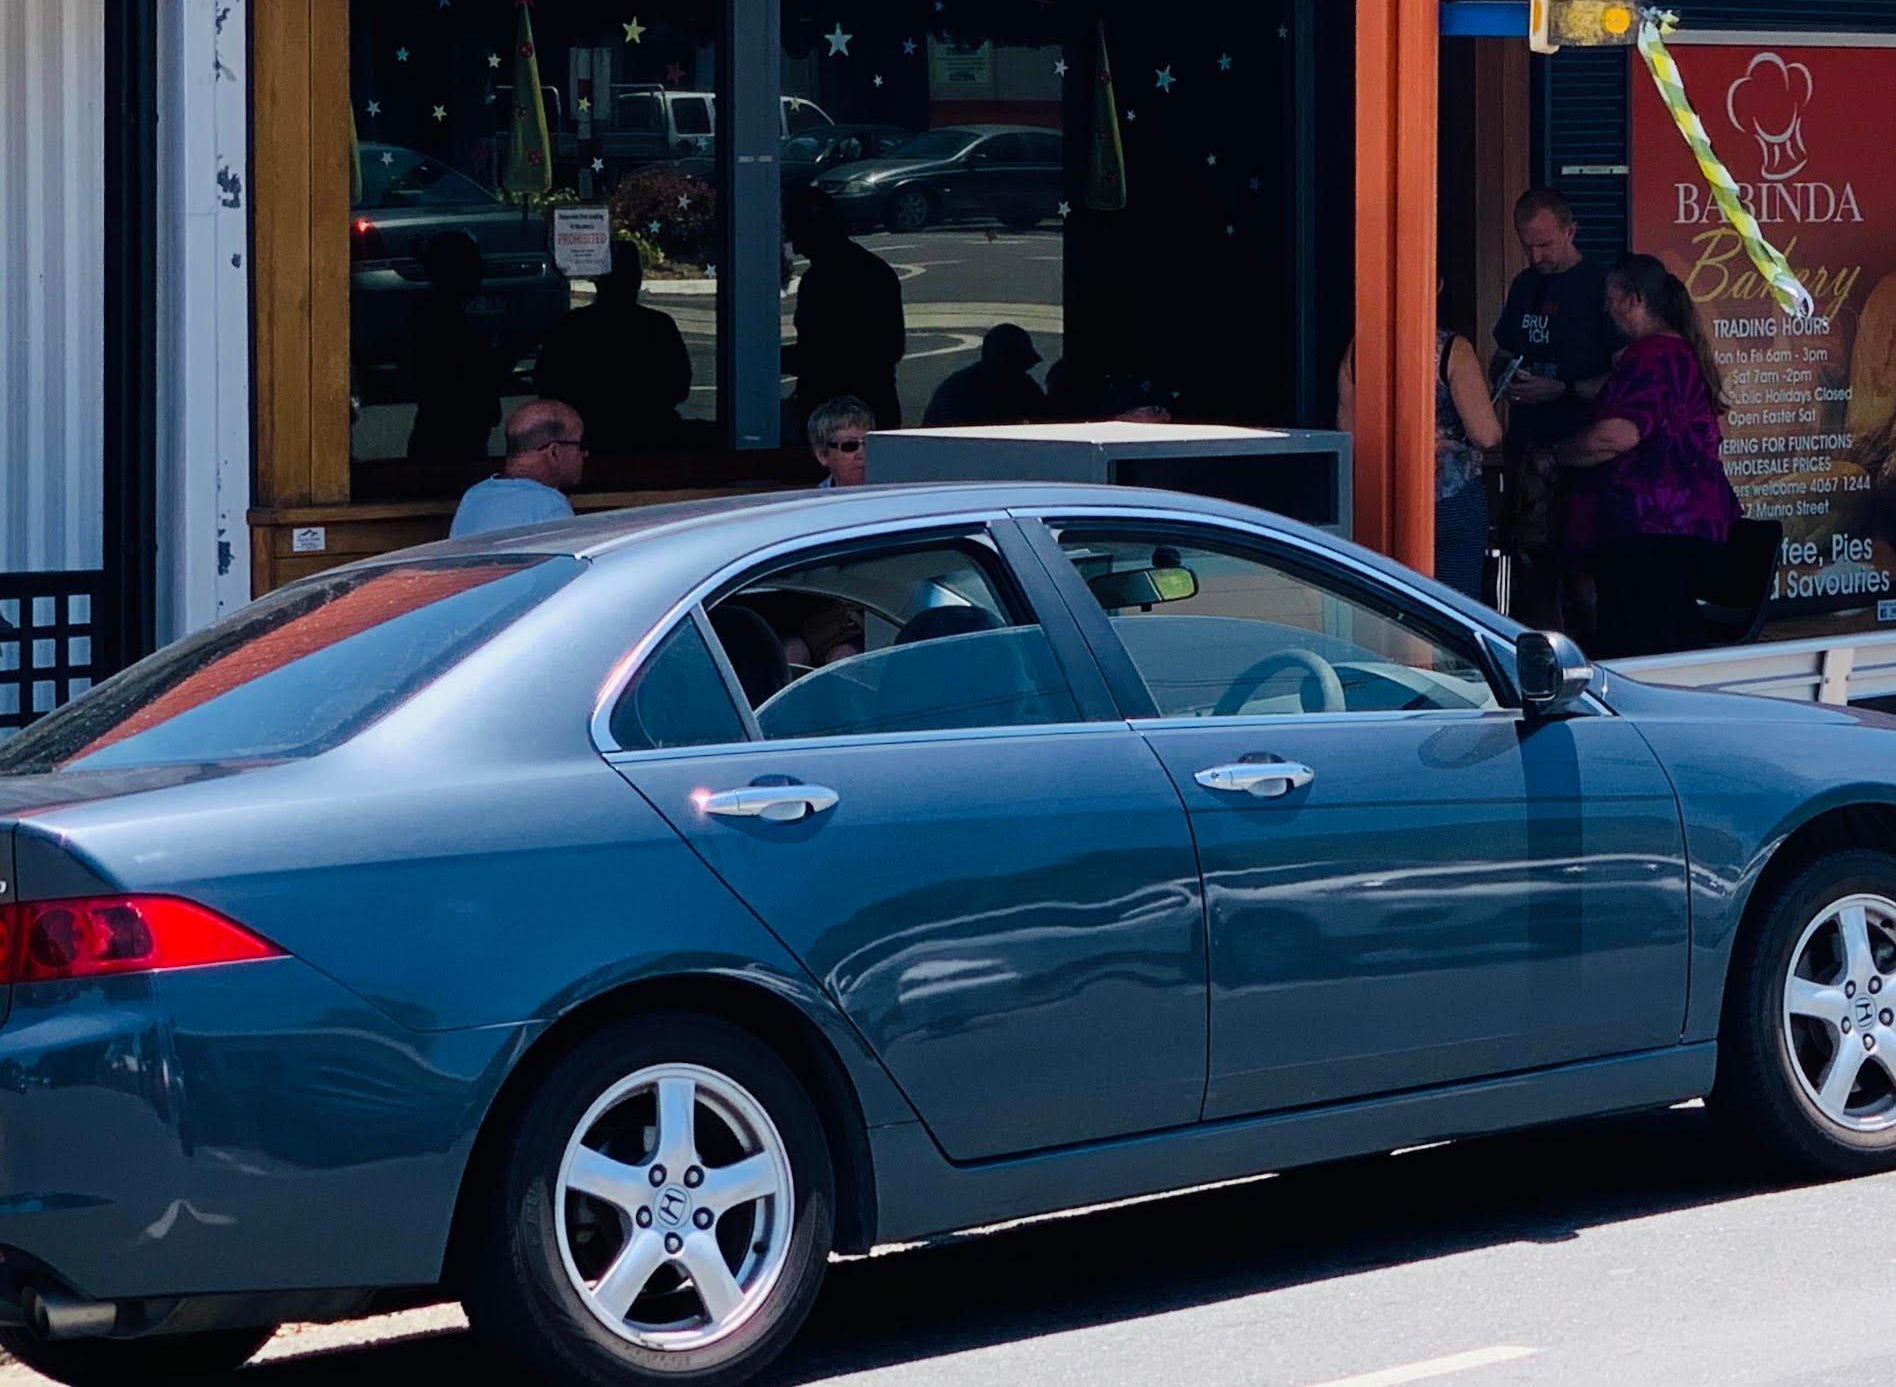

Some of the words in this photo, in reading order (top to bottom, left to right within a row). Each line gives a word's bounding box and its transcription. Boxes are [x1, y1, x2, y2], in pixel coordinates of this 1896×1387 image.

[1712, 318, 1776, 338] TRADING
[1782, 317, 1830, 336] HOURS
[1736, 349, 1748, 363] to
[1750, 349, 1763, 363] Fri
[1766, 348, 1791, 363] 6am
[1802, 346, 1828, 364] 3pm
[1731, 370, 1750, 384] Sat
[1754, 369, 1780, 383] 7am
[1765, 388, 1812, 405] Holidays
[1814, 386, 1853, 402] Closed
[1727, 411, 1760, 427] Open
[1763, 409, 1795, 424] Easter
[1798, 407, 1816, 422] Sat
[1761, 436, 1785, 453] FOR
[1787, 433, 1853, 451] FUNCTIONS
[1723, 459, 1789, 477] WHOLESALE
[1791, 456, 1832, 472] PRICES
[1733, 486, 1751, 498] ers
[1754, 481, 1808, 495] welcome
[1811, 477, 1837, 493] 4067
[1842, 475, 1871, 491] 1244
[1756, 501, 1793, 518] Munro
[1796, 498, 1830, 515] Street
[1778, 536, 1824, 568] fee,
[1832, 533, 1873, 562] Pies
[1786, 566, 1890, 599] Savouries
